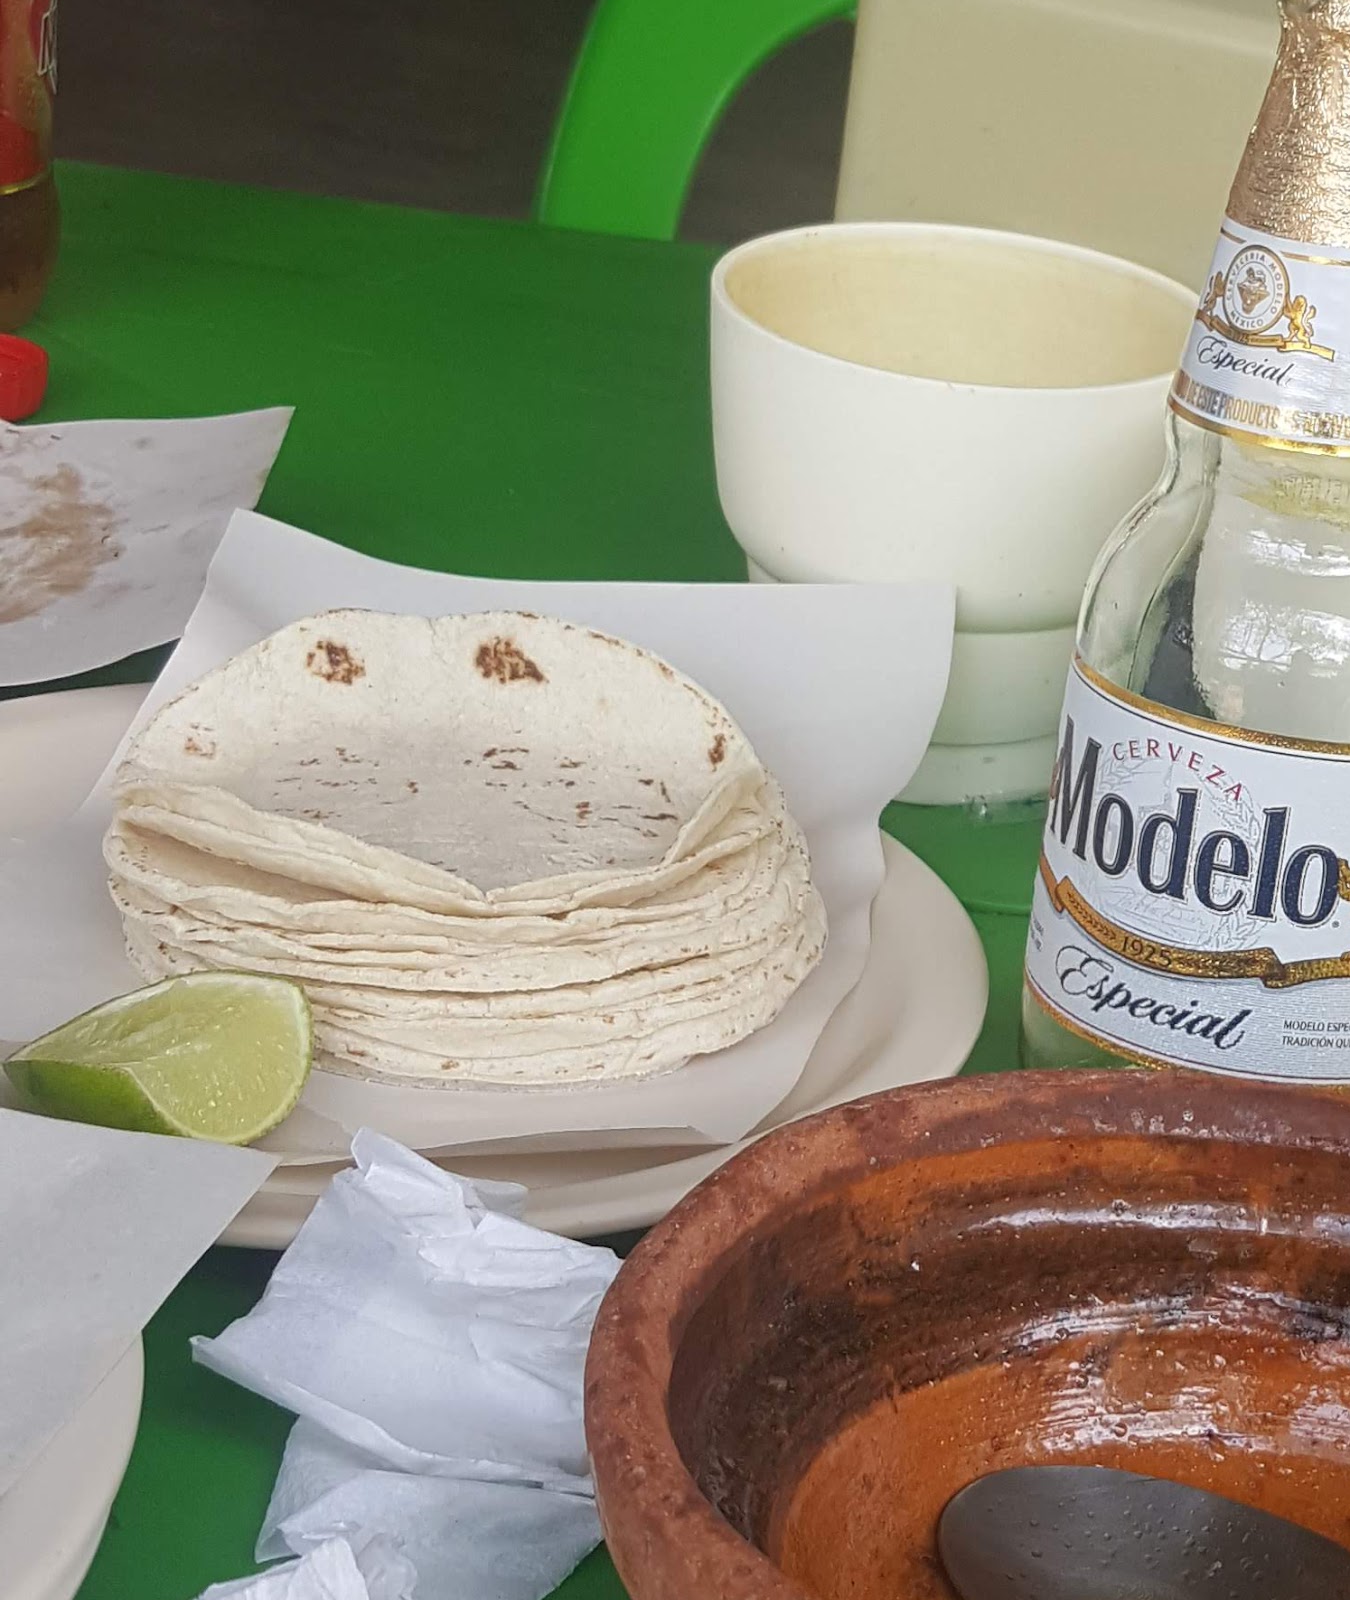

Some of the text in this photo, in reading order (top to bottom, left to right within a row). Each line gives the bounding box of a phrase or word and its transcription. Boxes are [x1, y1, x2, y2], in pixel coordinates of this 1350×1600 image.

[1197, 335, 1296, 386] Especial
[1111, 738, 1244, 802] CERVEZA
[1050, 714, 1344, 928] Modelo
[1120, 935, 1173, 968] 1925
[1055, 945, 1253, 1051] Especial
[1281, 1035, 1334, 1048] TRADICIÓN
[1283, 1019, 1325, 1032] MODELO
